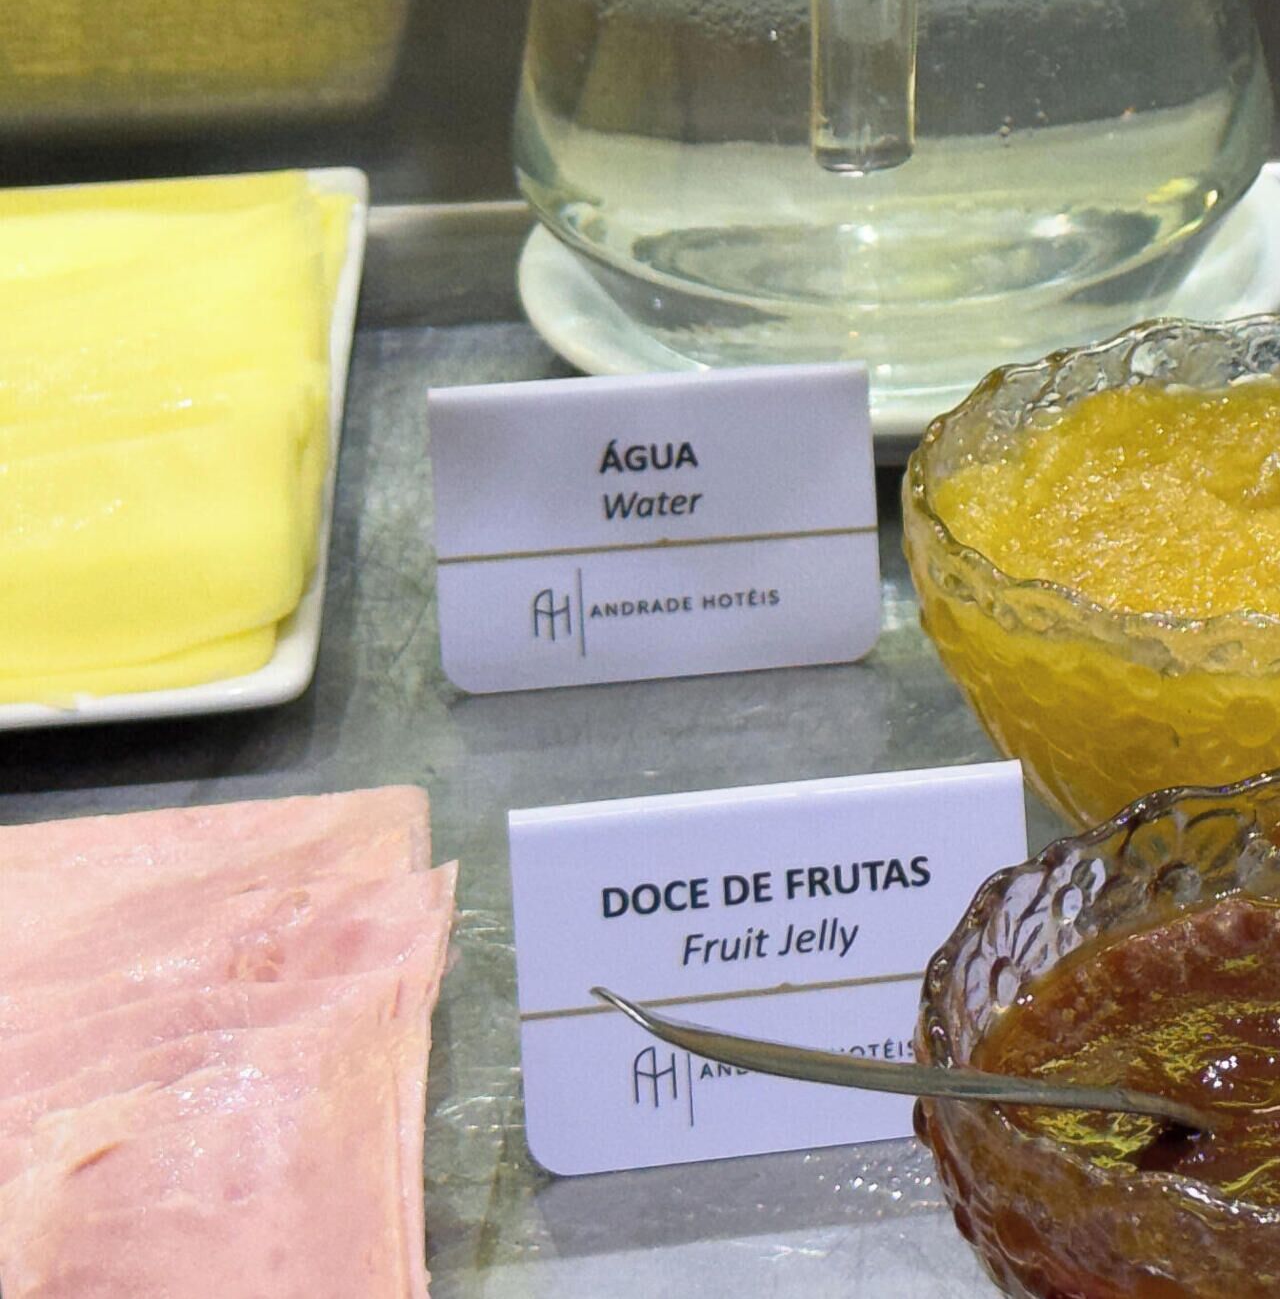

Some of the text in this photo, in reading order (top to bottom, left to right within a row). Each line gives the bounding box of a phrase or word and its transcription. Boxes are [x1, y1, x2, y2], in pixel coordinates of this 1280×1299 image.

[599, 438, 699, 475] ÁGUA
[602, 491, 704, 521] Water
[589, 596, 693, 619] ANDRADE
[701, 588, 781, 611] HOTÉIS
[601, 855, 931, 919] DOCE DE FRUTAS
[682, 917, 860, 967] Fruit Jelly
